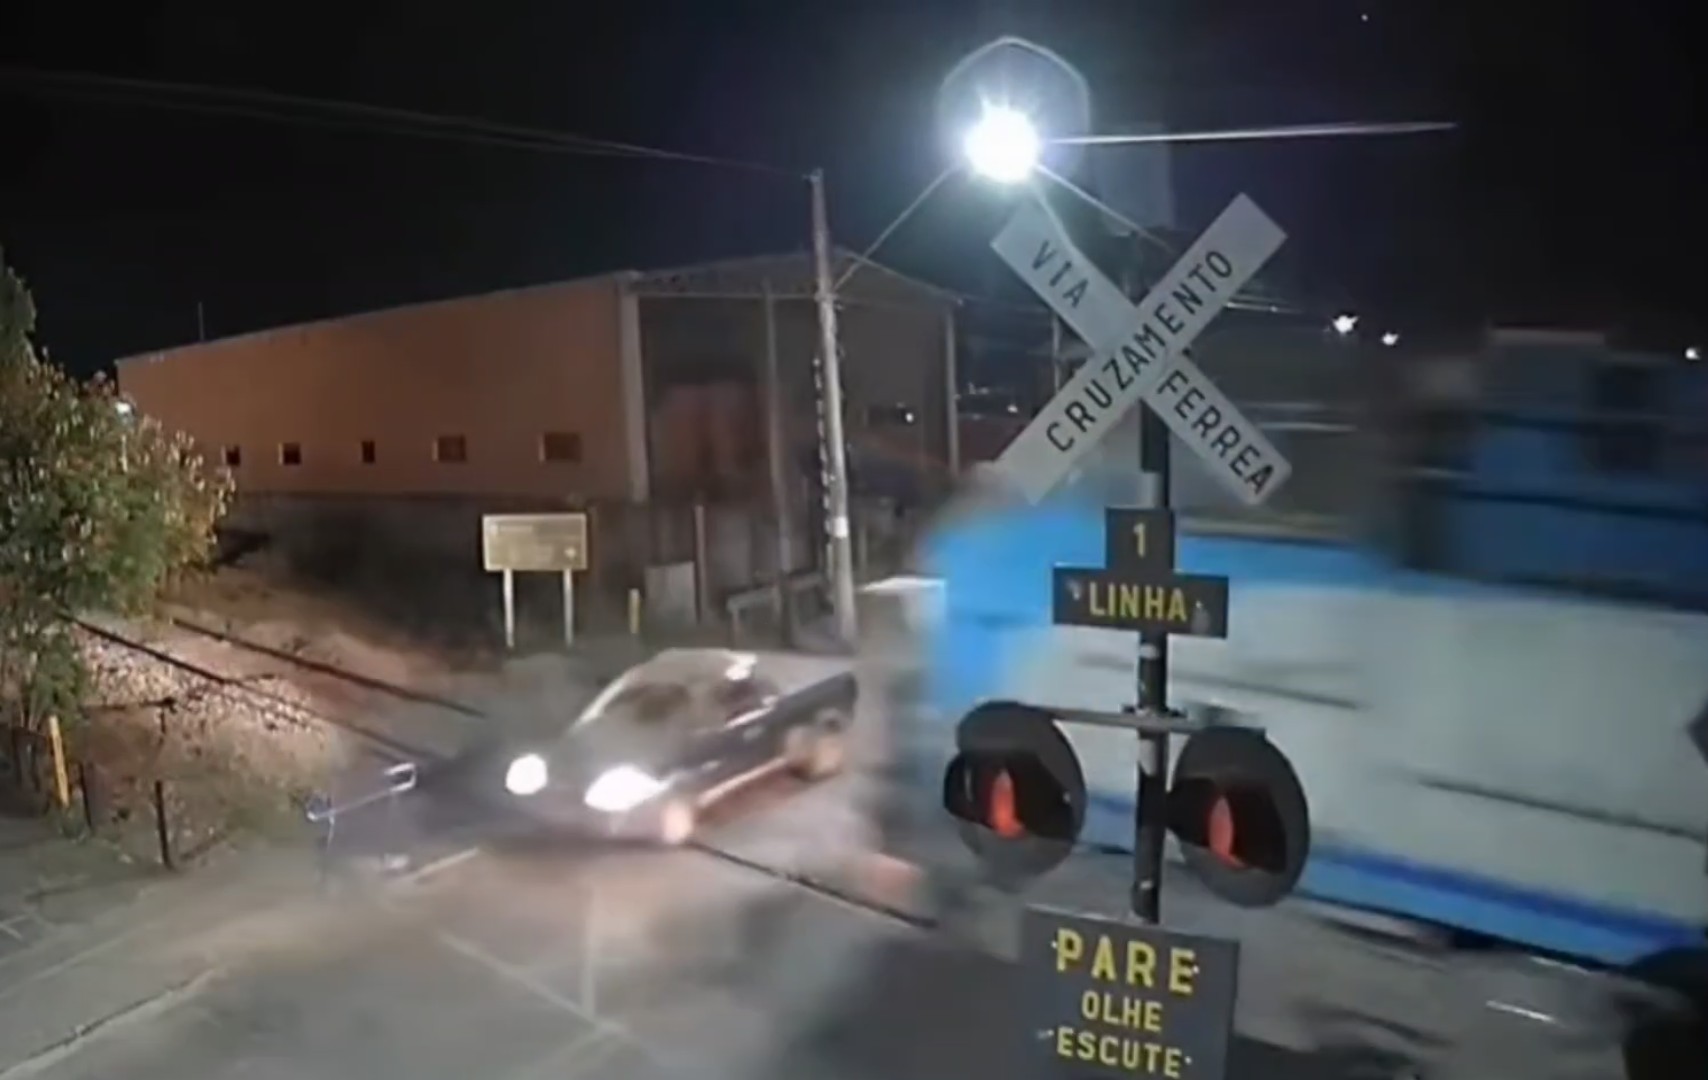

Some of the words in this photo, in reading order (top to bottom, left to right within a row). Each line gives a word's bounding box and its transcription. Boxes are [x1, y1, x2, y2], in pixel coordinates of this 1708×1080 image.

[1031, 241, 1089, 308] VIA
[1157, 370, 1275, 494] FERREA
[1046, 250, 1233, 452] CRUZAMENTO
[1133, 523, 1146, 557] 1
[1089, 581, 1187, 622] LINHA
[1056, 927, 1196, 994] PARE
[1081, 990, 1163, 1032] OLHE
[1056, 1026, 1182, 1078] ESCUTE
